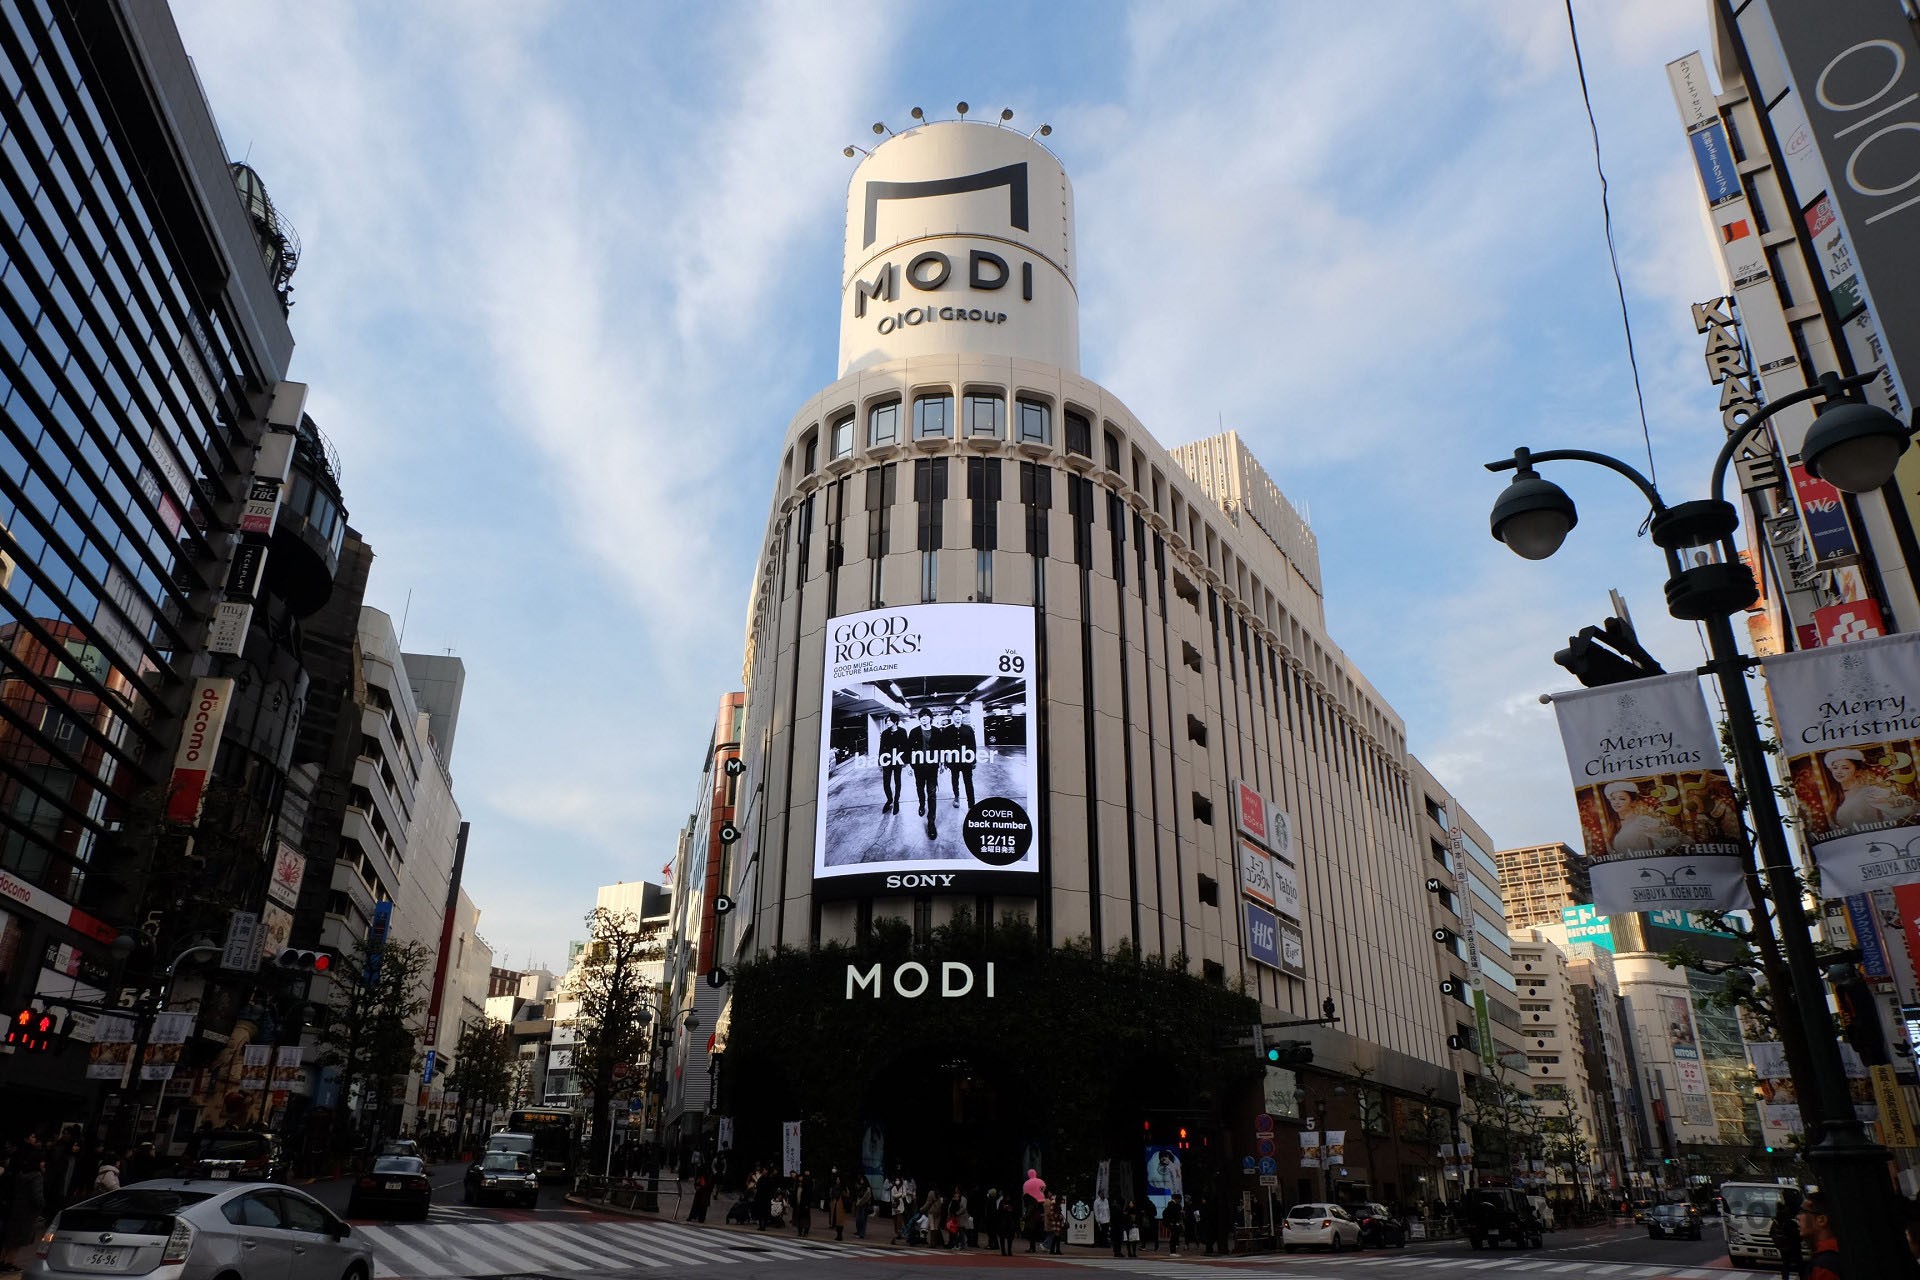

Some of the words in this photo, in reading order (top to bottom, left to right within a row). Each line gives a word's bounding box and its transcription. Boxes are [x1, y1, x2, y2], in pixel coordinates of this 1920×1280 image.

[854, 249, 1032, 319] MODI
[939, 306, 1008, 325] GROUP
[1691, 296, 1780, 494] KARAOKE
[252, 491, 276, 501] TBC
[1804, 497, 1839, 514] We
[249, 506, 272, 516] TBC
[1827, 547, 1844, 558] 4F
[834, 616, 908, 645] GOOD
[835, 634, 922, 664] ROCKS!
[833, 664, 852, 673] GOOD
[853, 661, 873, 670] MUSIC
[833, 668, 862, 678] CULTURE
[863, 663, 898, 673] MAGAZINE
[998, 655, 1025, 674] 89
[1819, 696, 1905, 718] Merry
[186, 688, 219, 762] docomo
[1600, 732, 1672, 753] Merry
[854, 747, 904, 769] back
[911, 745, 998, 765] number
[1584, 750, 1702, 777] Christmas
[982, 809, 1014, 818] COVER
[968, 820, 991, 829] back
[992, 820, 1027, 830] number
[1851, 819, 1897, 833] Amuro
[979, 835, 1016, 846] 12/15
[1453, 842, 1466, 880] 日本生命
[1626, 847, 1666, 859] Amuro
[1250, 855, 1265, 875] エース
[1861, 861, 1900, 879] SHIBUYA
[886, 874, 956, 888] SONY
[1246, 868, 1271, 893] コンタクト
[1275, 873, 1297, 900] Tabio
[1632, 887, 1666, 900] SHIBUYA
[1671, 887, 1692, 899] KOEN
[1693, 887, 1713, 898] DORI
[1252, 920, 1274, 951] HIS
[1567, 923, 1609, 938] NITORI
[846, 962, 995, 1000] MODI
[1674, 1048, 1698, 1058] NITORI
